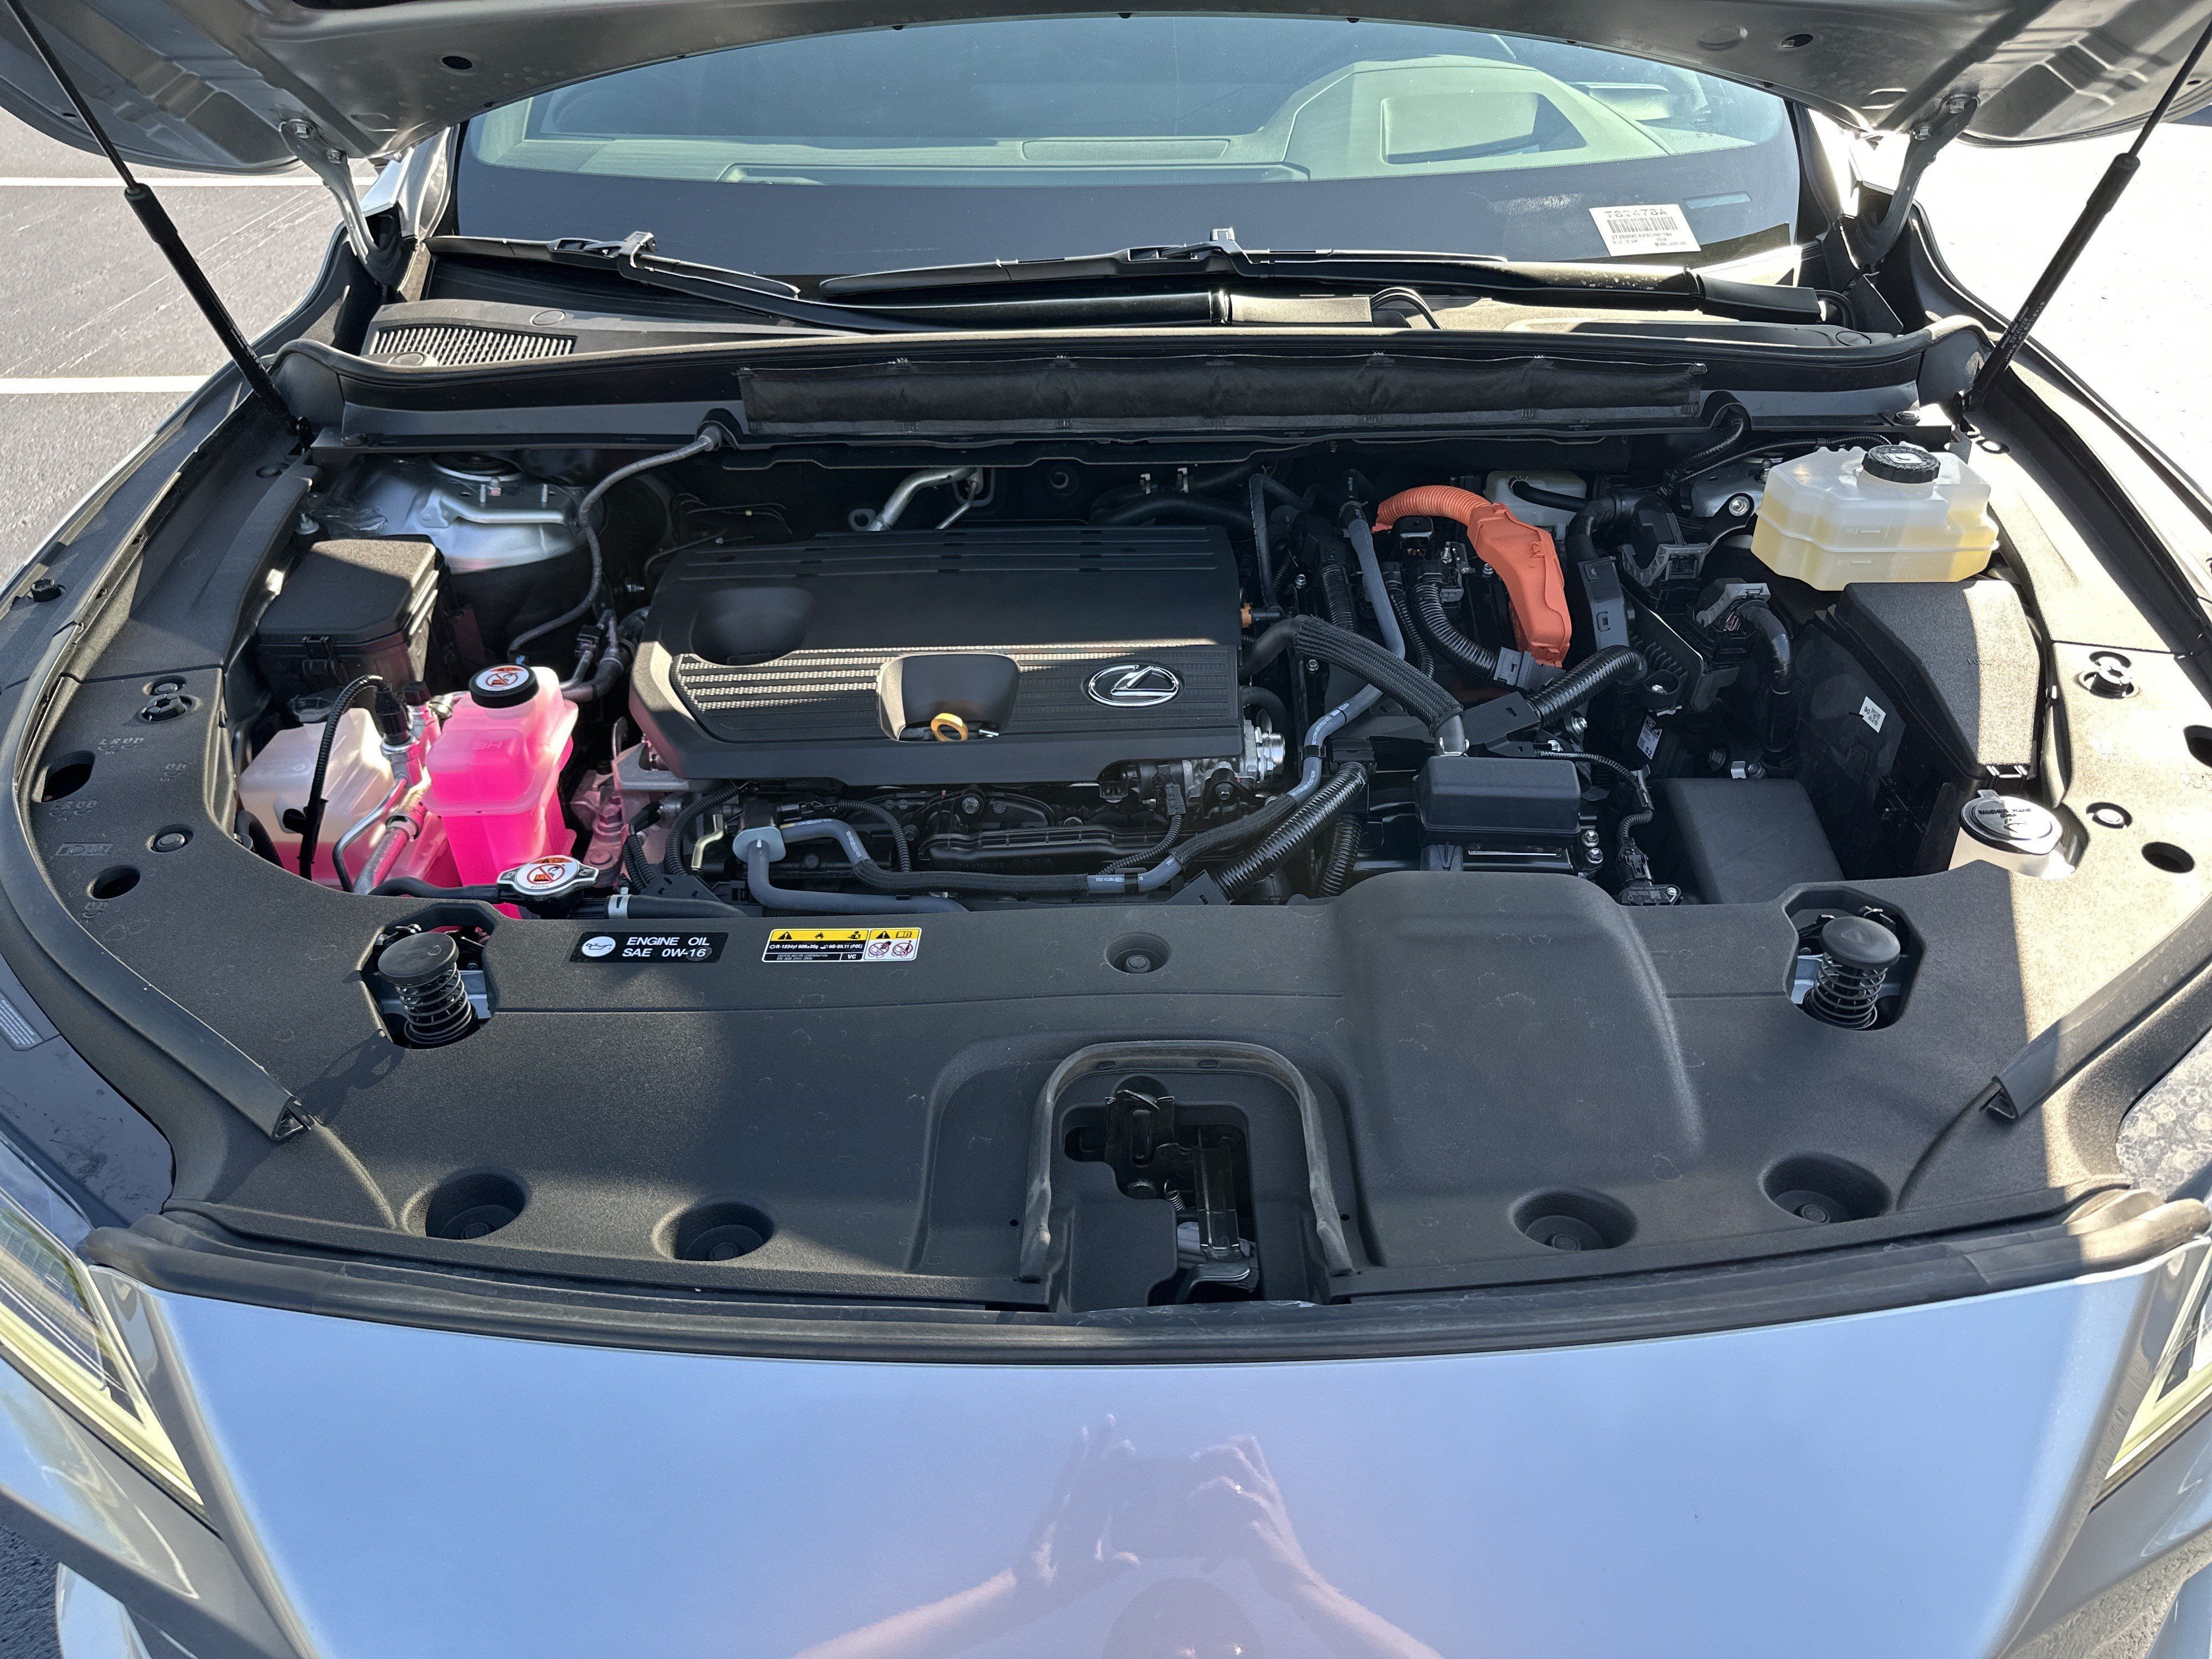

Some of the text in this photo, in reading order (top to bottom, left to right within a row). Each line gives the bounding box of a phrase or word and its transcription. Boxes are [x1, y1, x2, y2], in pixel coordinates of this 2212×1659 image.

[627, 937, 710, 945] ENGINE OIL
[622, 948, 706, 957] SAE 0W-16
